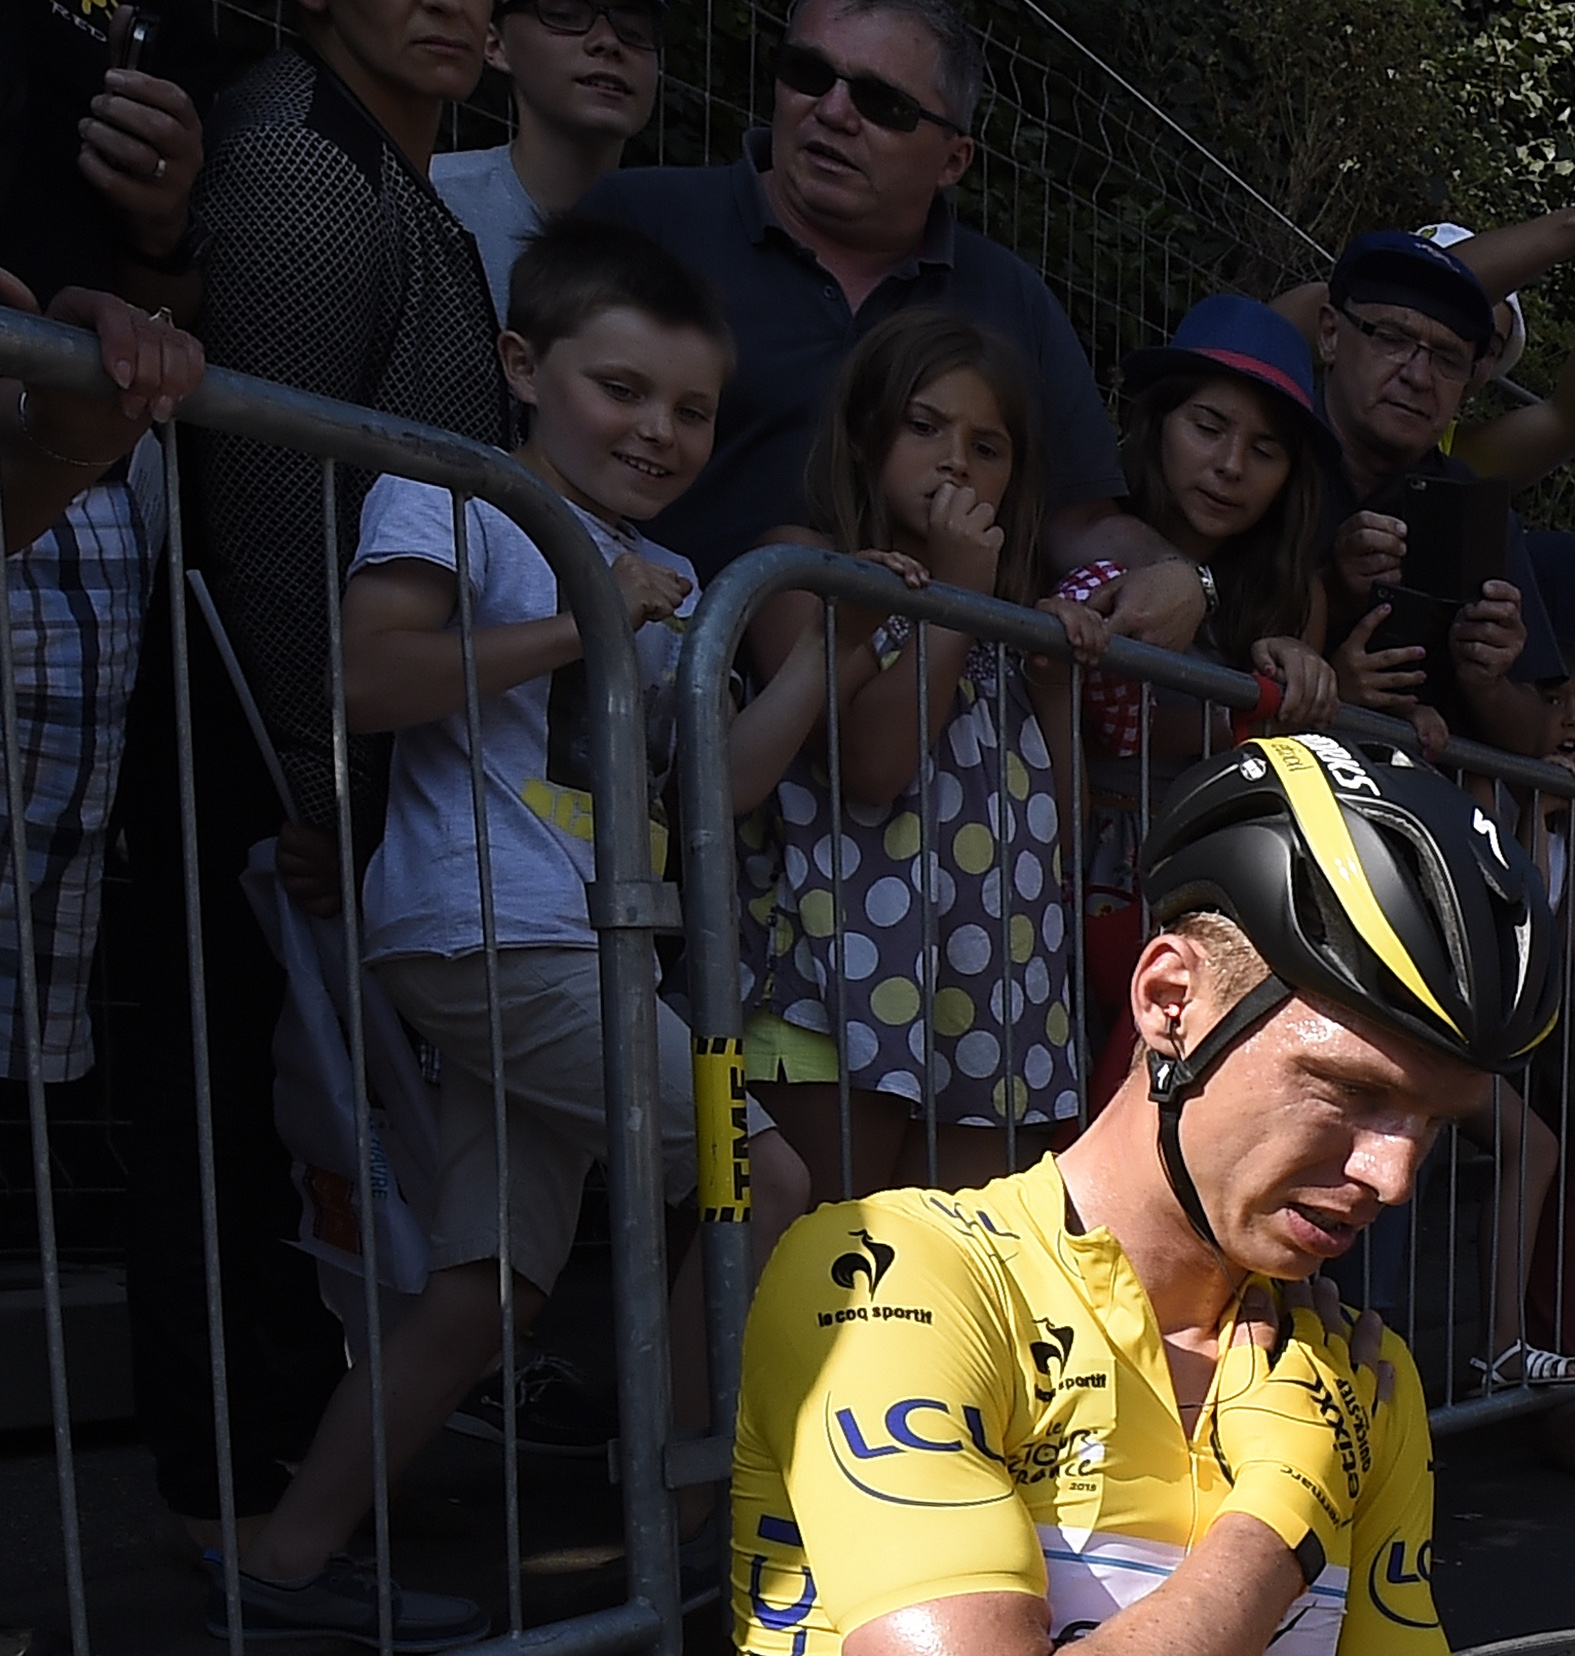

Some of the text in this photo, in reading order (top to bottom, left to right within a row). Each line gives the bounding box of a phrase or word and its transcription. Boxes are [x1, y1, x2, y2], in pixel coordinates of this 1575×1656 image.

[834, 1305, 869, 1325] coq
[871, 1304, 933, 1327] sportif
[834, 1397, 1006, 1464] LCL
